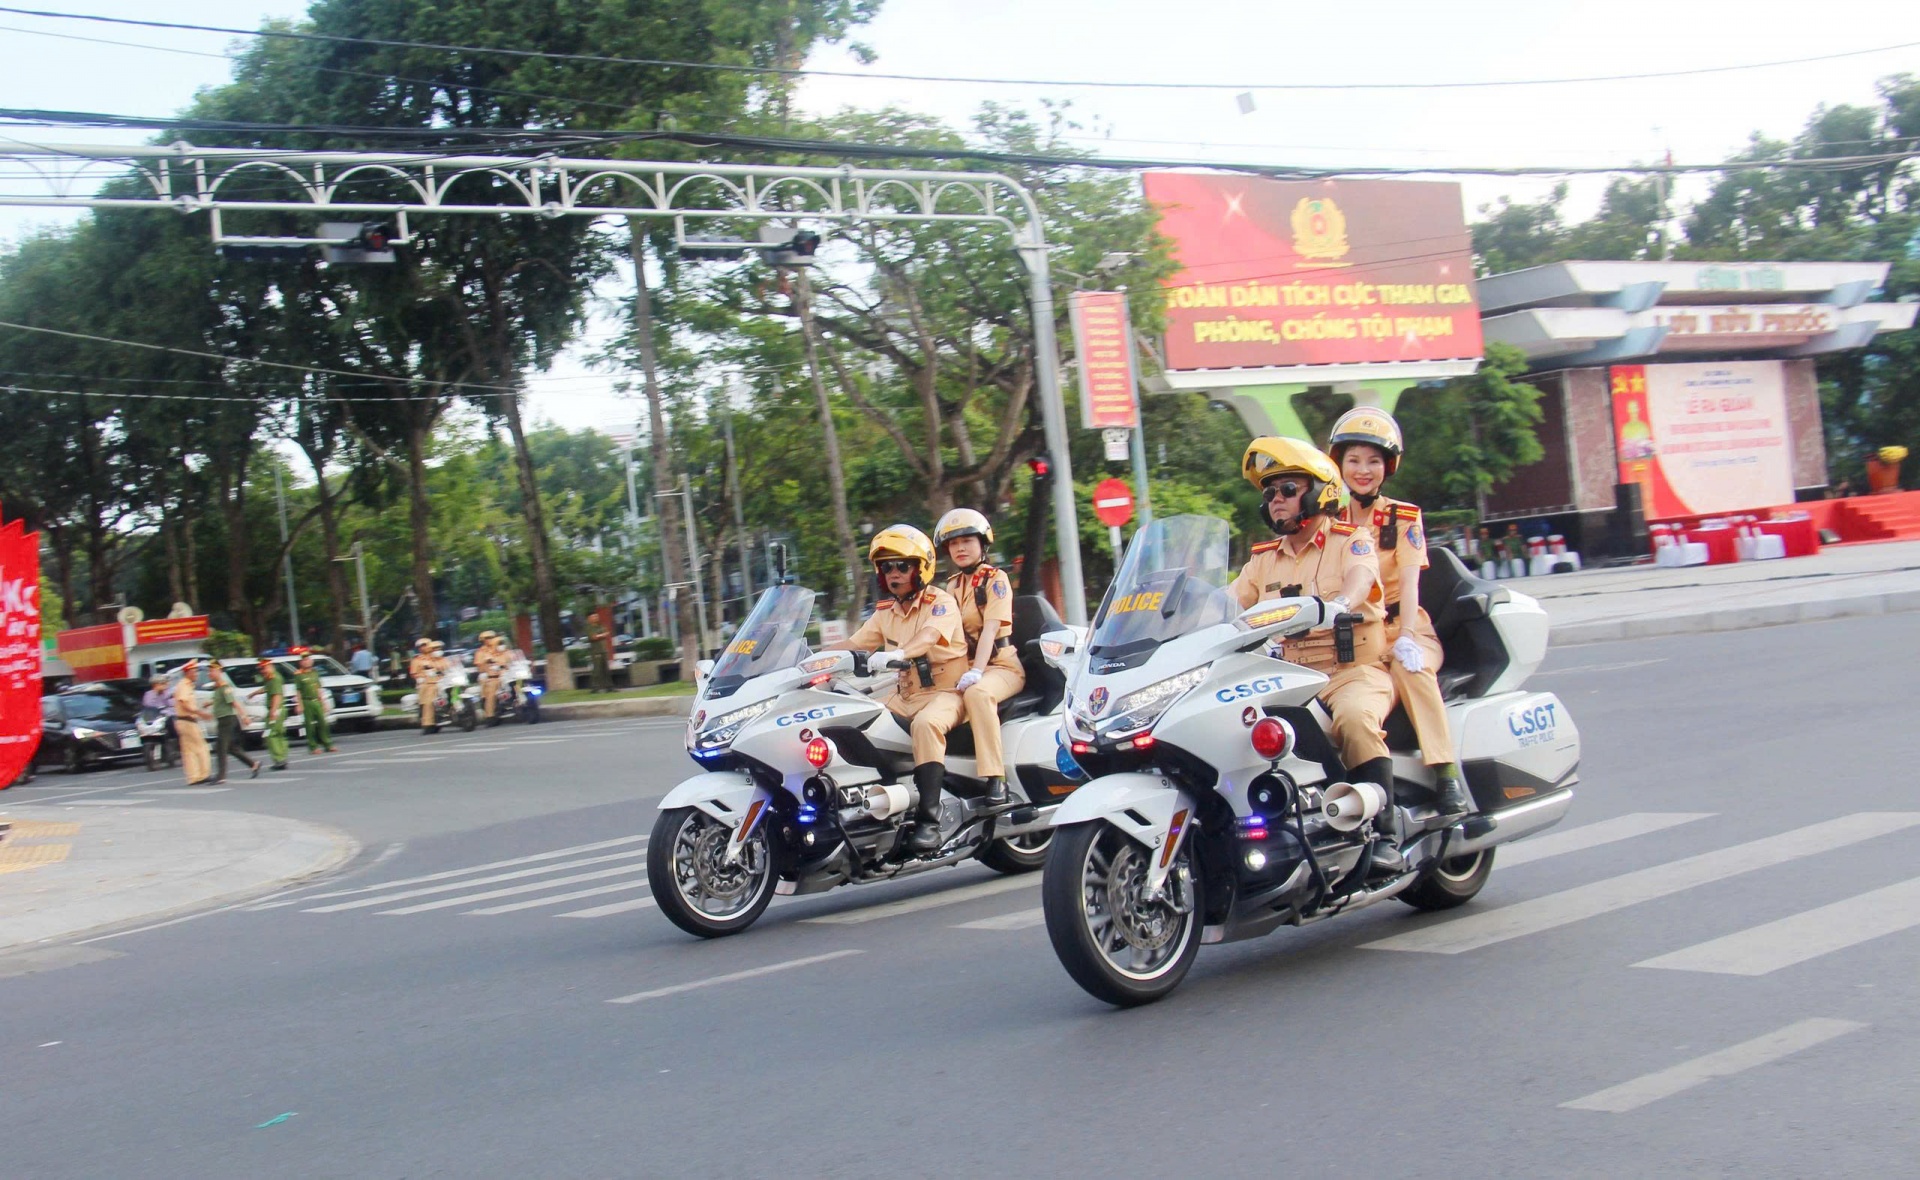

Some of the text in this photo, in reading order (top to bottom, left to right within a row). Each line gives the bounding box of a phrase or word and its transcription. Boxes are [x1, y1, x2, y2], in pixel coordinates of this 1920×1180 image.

[1280, 280, 1331, 306] TÍCH
[1376, 284, 1435, 304] THAM
[1436, 284, 1472, 304] GIA
[1281, 312, 1357, 340] CHỐNG
[1358, 312, 1393, 342] TỘI
[1106, 592, 1164, 618] POLICE
